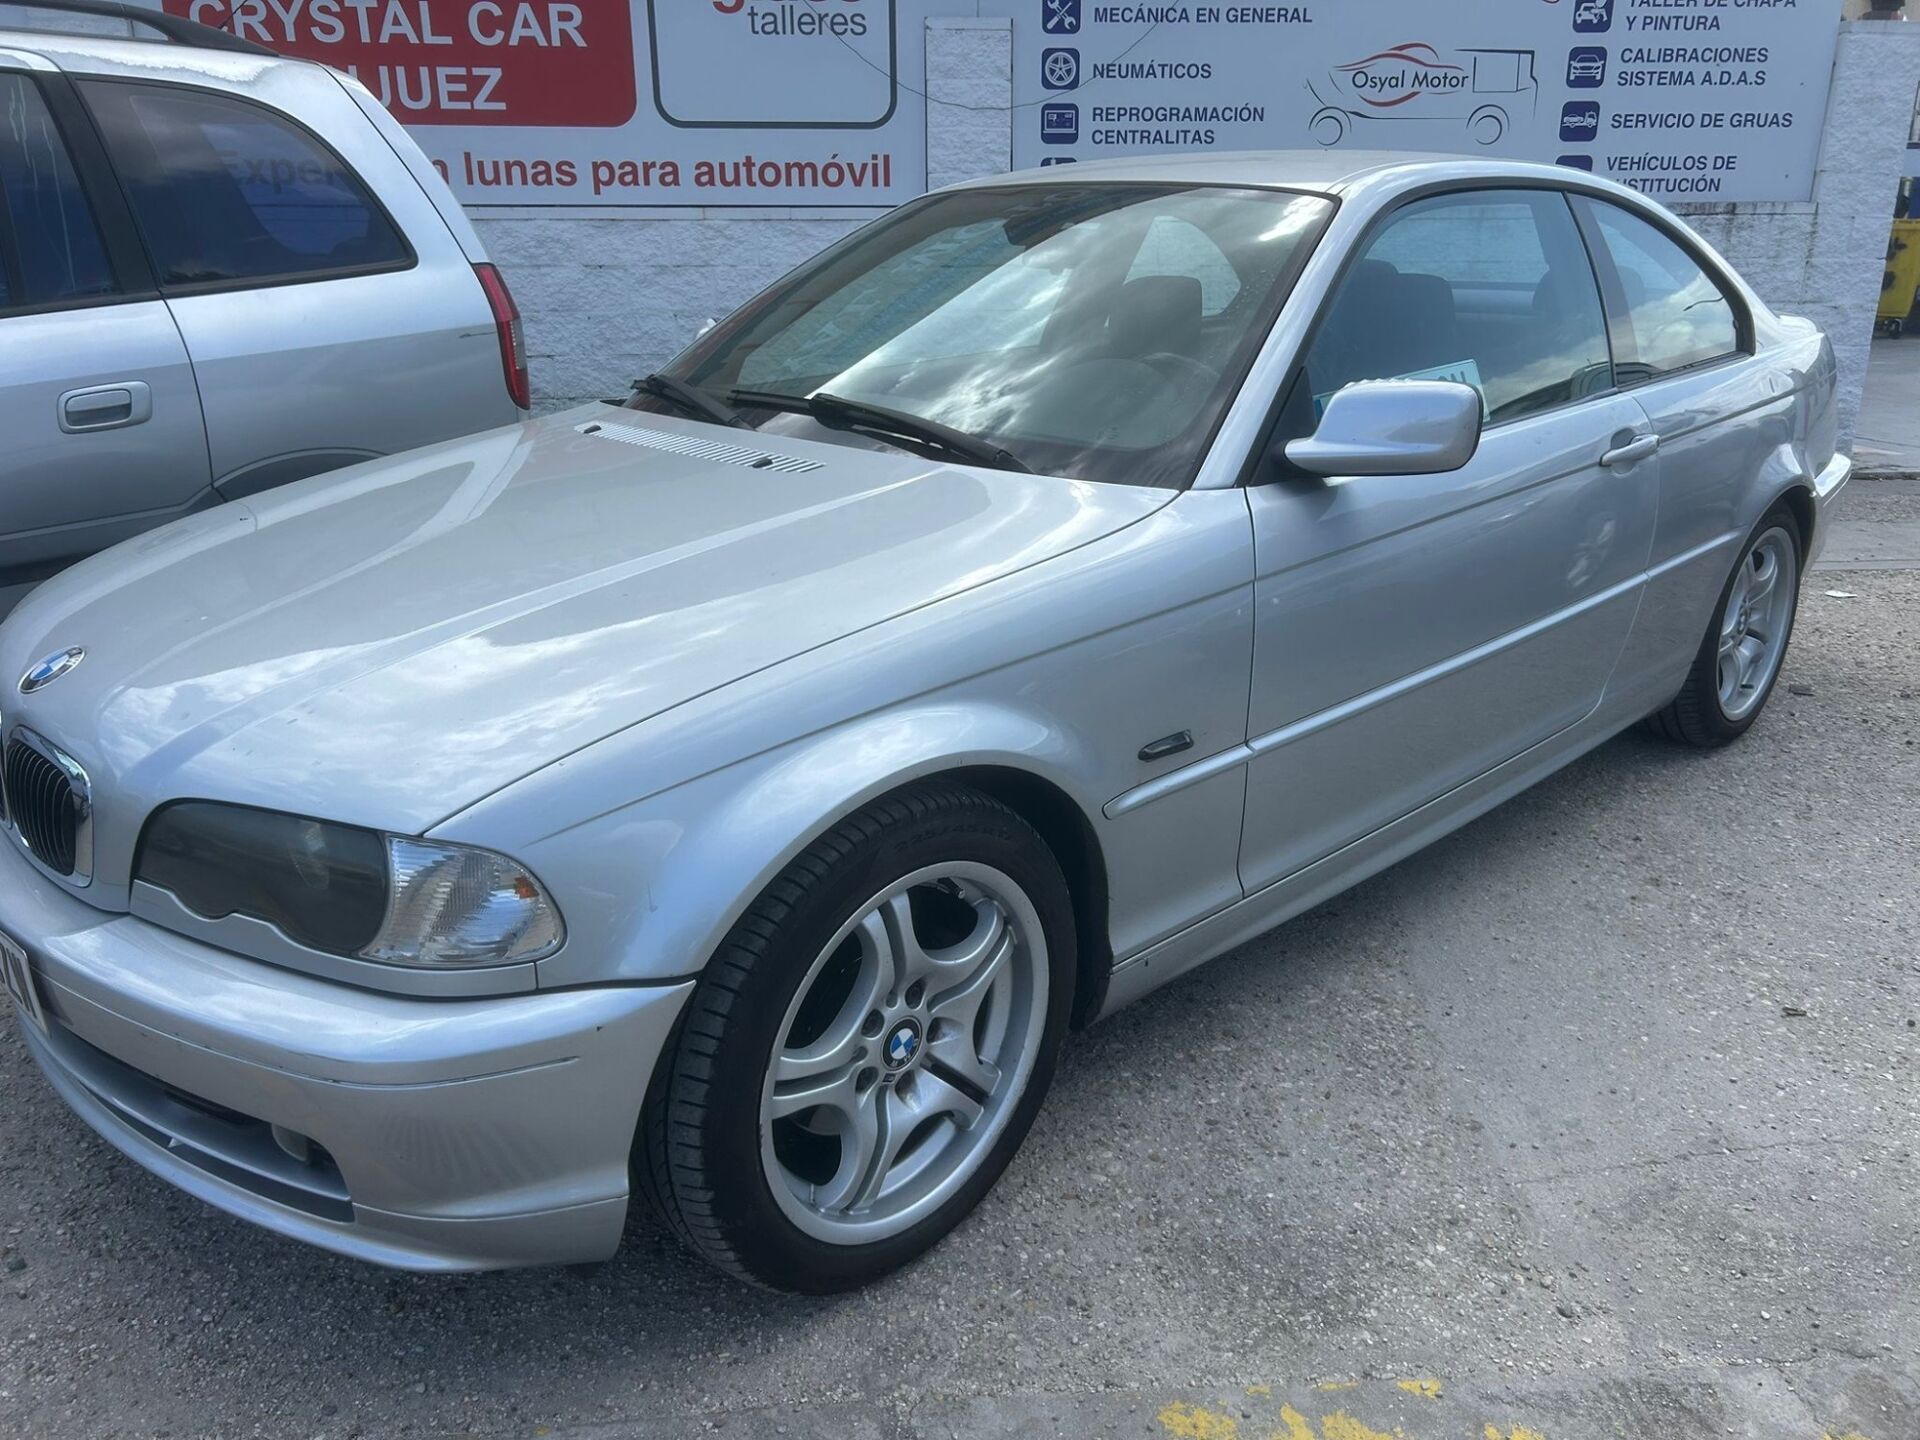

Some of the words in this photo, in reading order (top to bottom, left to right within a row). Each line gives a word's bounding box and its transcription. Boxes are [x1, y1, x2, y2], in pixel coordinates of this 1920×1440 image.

[747, 5, 867, 36] talleres
[1094, 3, 1190, 24] MECÁNICA
[1196, 8, 1220, 23] EN
[1226, 7, 1313, 24] GENERAL
[190, 0, 453, 45] CRYSTAL
[468, 0, 588, 47] CAR
[1626, 16, 1637, 31] Y
[1641, 16, 1721, 31] PINTURA
[1620, 48, 1769, 64] CALIBRACIONES
[1092, 60, 1212, 79] NEUMÁTICOS
[1617, 71, 1695, 87] SISTEMA
[1701, 70, 1766, 86] A.D.A.S
[348, 64, 507, 111] JUEZ
[1352, 69, 1406, 93] Osyal
[1411, 71, 1469, 89] Motor
[1091, 102, 1265, 123] REPROGRAMACIÓN
[1611, 113, 1695, 129] SERVICIO
[1700, 113, 1725, 128] DE
[1729, 113, 1793, 128] GRUAS
[1091, 129, 1215, 145] CENTRALITAS
[1606, 152, 1708, 171] VEHÍCULOS
[1712, 155, 1738, 170] DE
[463, 152, 578, 187] lunas
[592, 160, 681, 195] para
[693, 153, 892, 188] automóvil
[1616, 174, 1722, 193] STITUCIÓN
